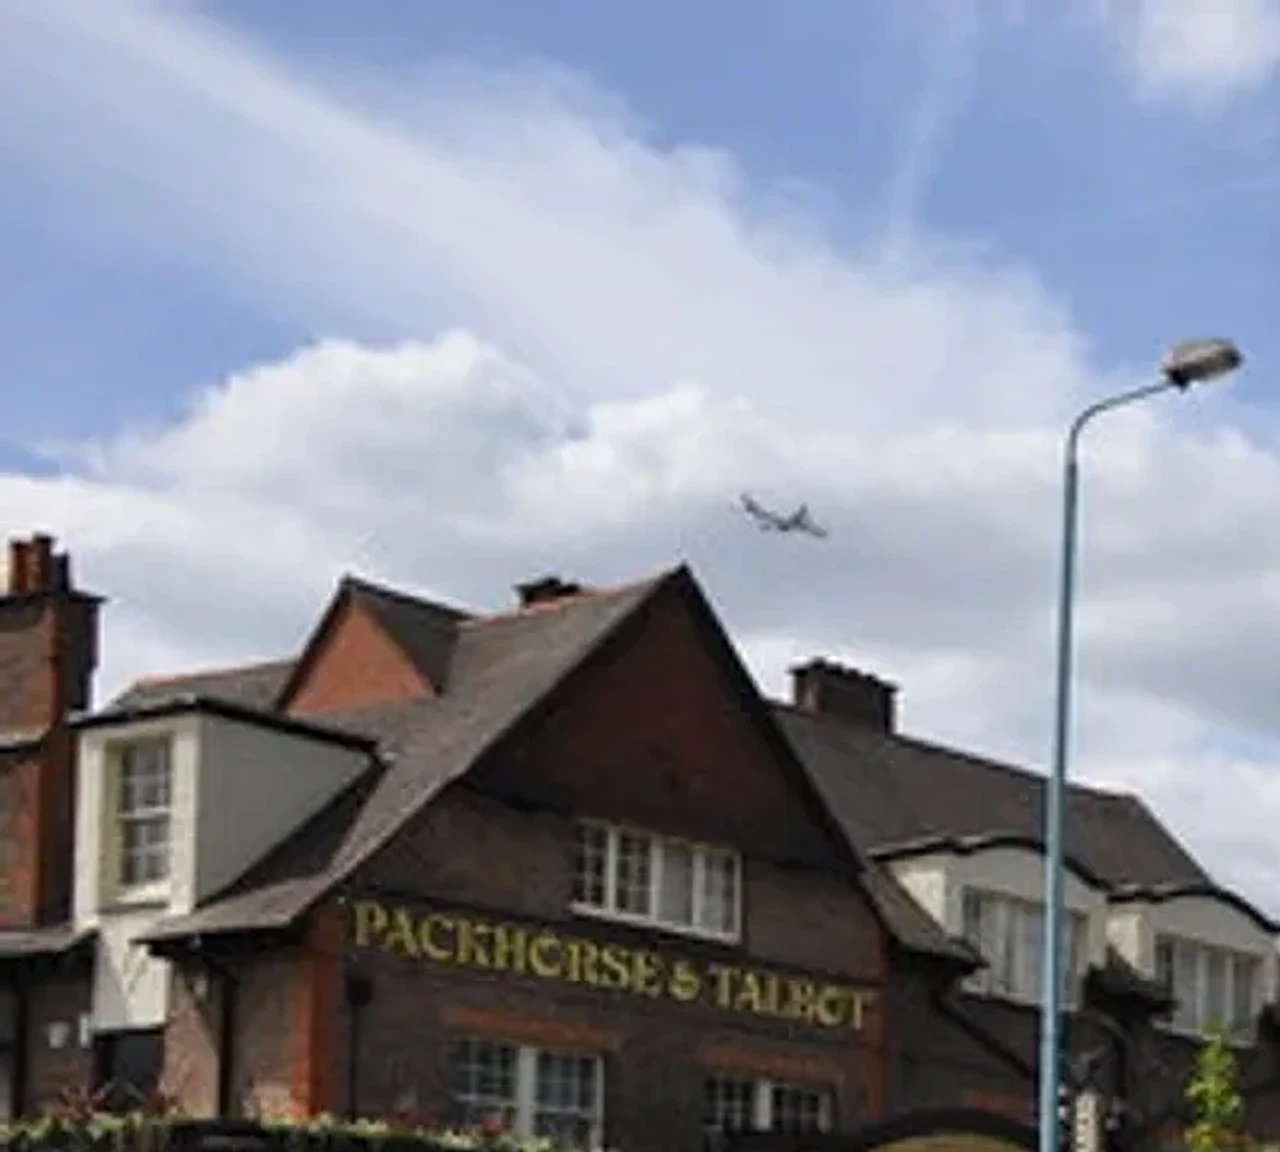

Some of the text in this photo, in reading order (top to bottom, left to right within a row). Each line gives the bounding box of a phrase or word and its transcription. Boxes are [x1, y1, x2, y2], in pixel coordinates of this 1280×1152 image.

[353, 901, 877, 1031] PACKHORSE & TALBOT
